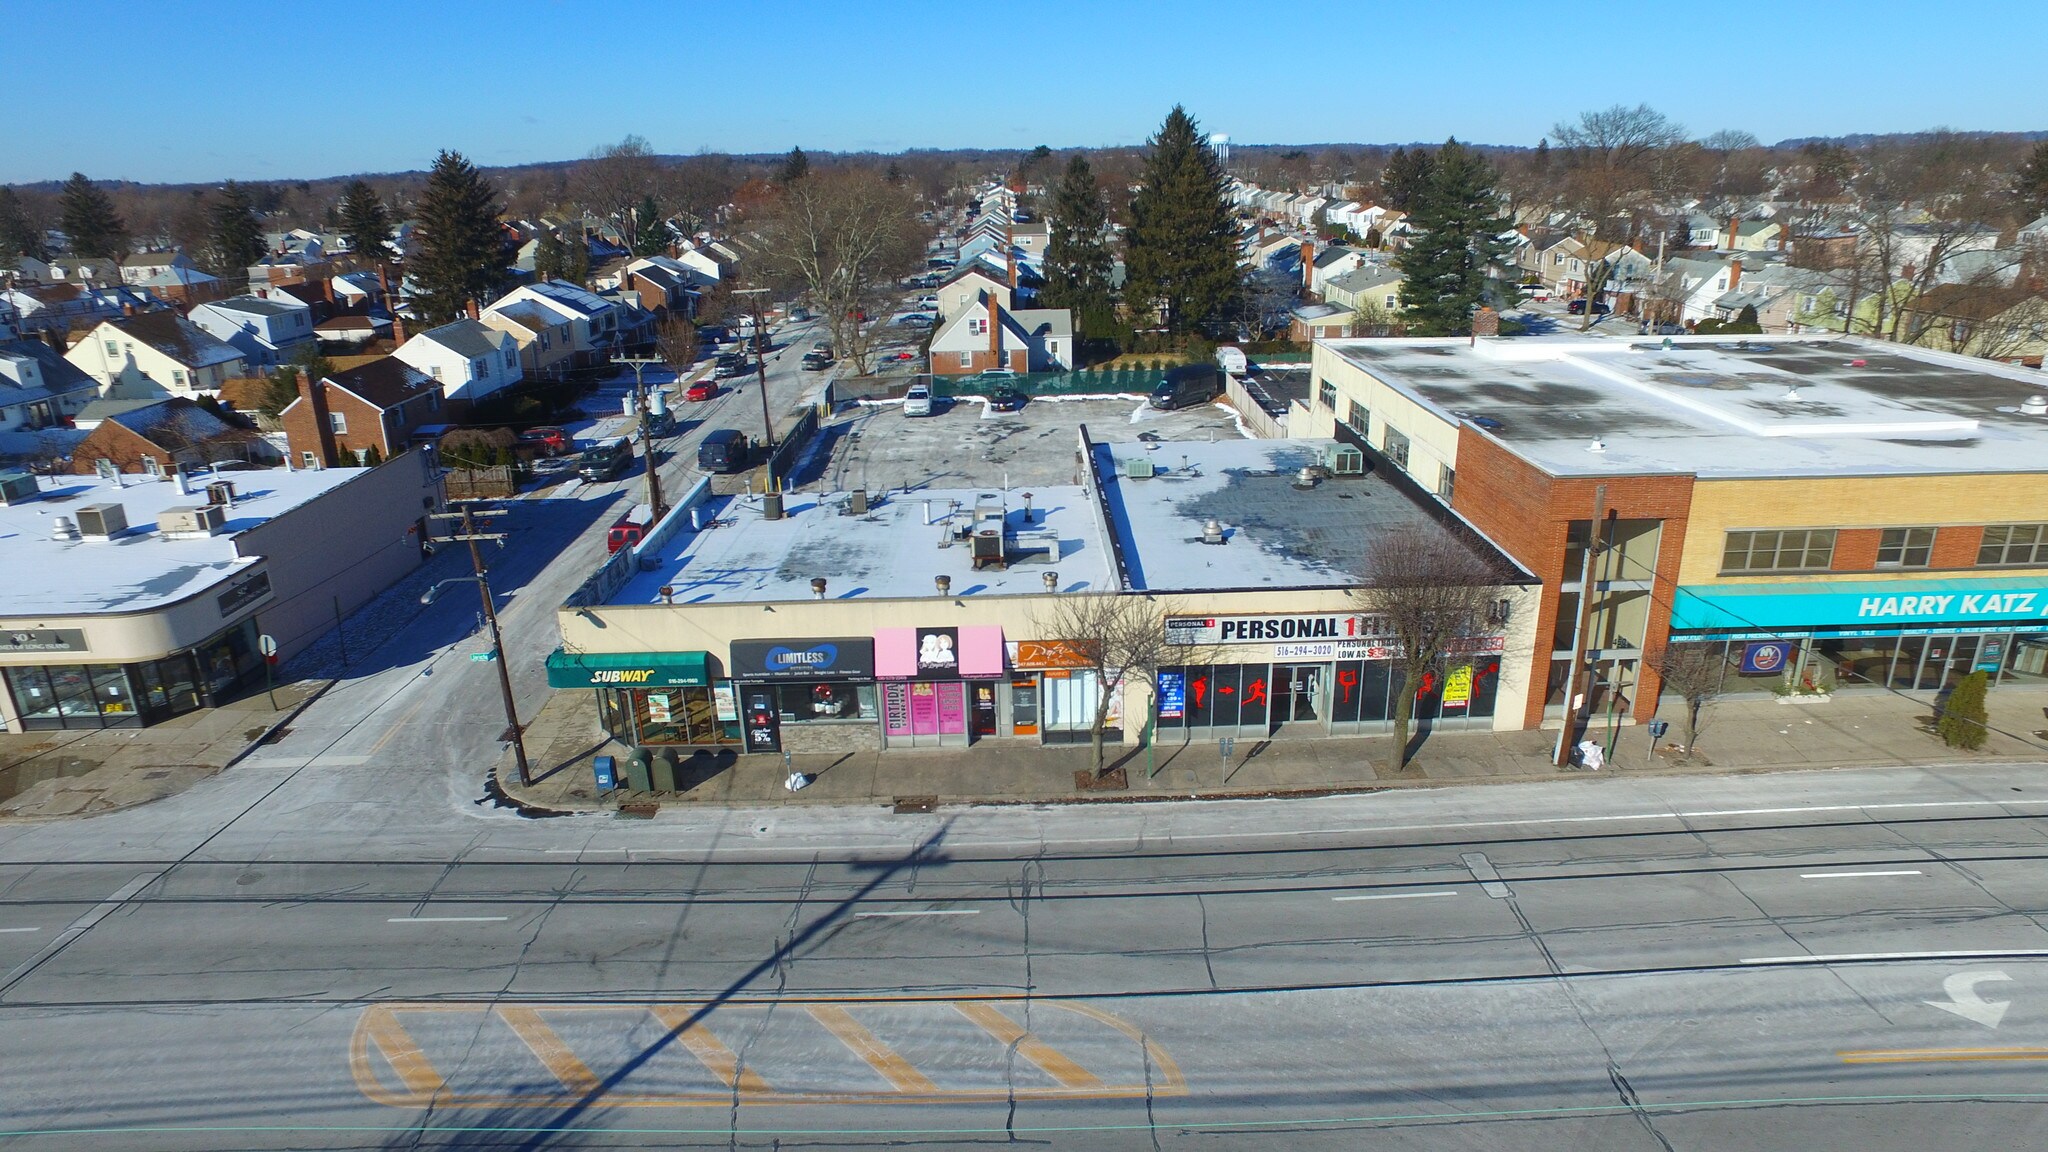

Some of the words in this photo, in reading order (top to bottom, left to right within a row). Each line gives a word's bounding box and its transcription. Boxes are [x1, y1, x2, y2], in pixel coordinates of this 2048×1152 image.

[1858, 595, 1955, 616] HARRY
[1959, 593, 2038, 614] KATZ
[1222, 618, 1338, 640] PERSONAL
[1344, 617, 1355, 636] 1
[1277, 645, 1332, 656] 516-294-3020
[1338, 650, 1354, 658] LOW
[1356, 650, 1366, 658] AS
[1760, 648, 1776, 659] NY
[778, 652, 824, 664] LIMITLESS
[590, 669, 655, 683] SUBWAY
